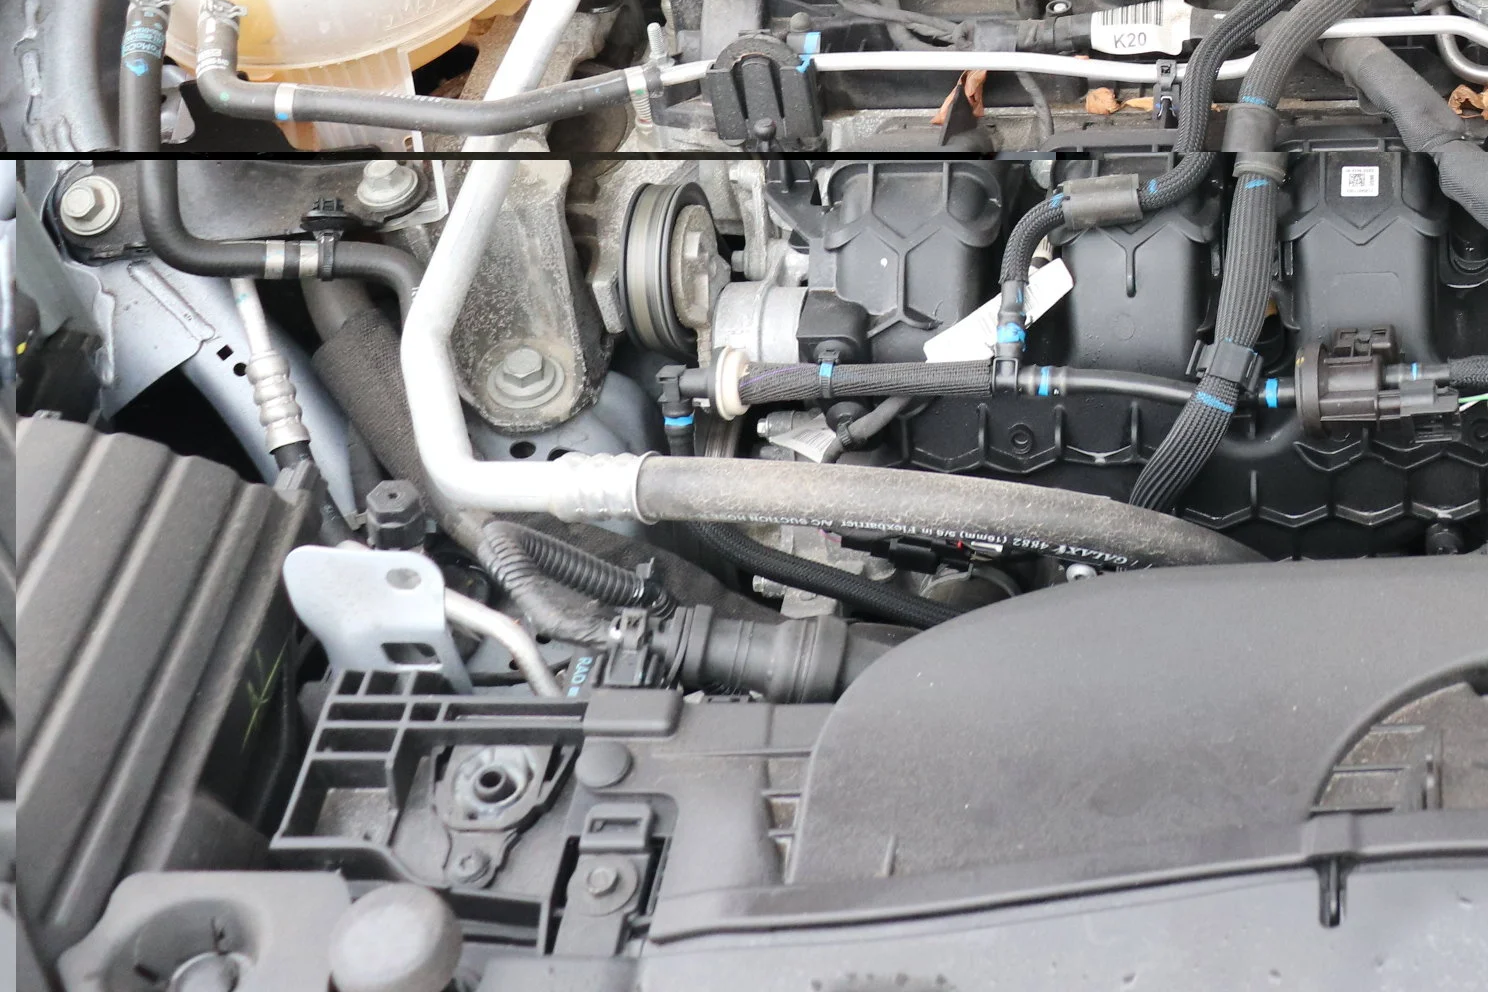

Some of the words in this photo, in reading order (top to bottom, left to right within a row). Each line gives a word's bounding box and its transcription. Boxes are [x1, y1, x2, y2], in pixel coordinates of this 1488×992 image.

[1113, 31, 1148, 49] K20
[749, 514, 808, 526] SUCTION
[810, 518, 834, 528] A/C
[840, 519, 916, 536] Flexbarrier
[921, 527, 934, 537] in
[960, 530, 1008, 545] (16mm)
[1012, 537, 1050, 551] 4882
[1051, 542, 1129, 565] GALAXY
[571, 656, 593, 685] RAD
